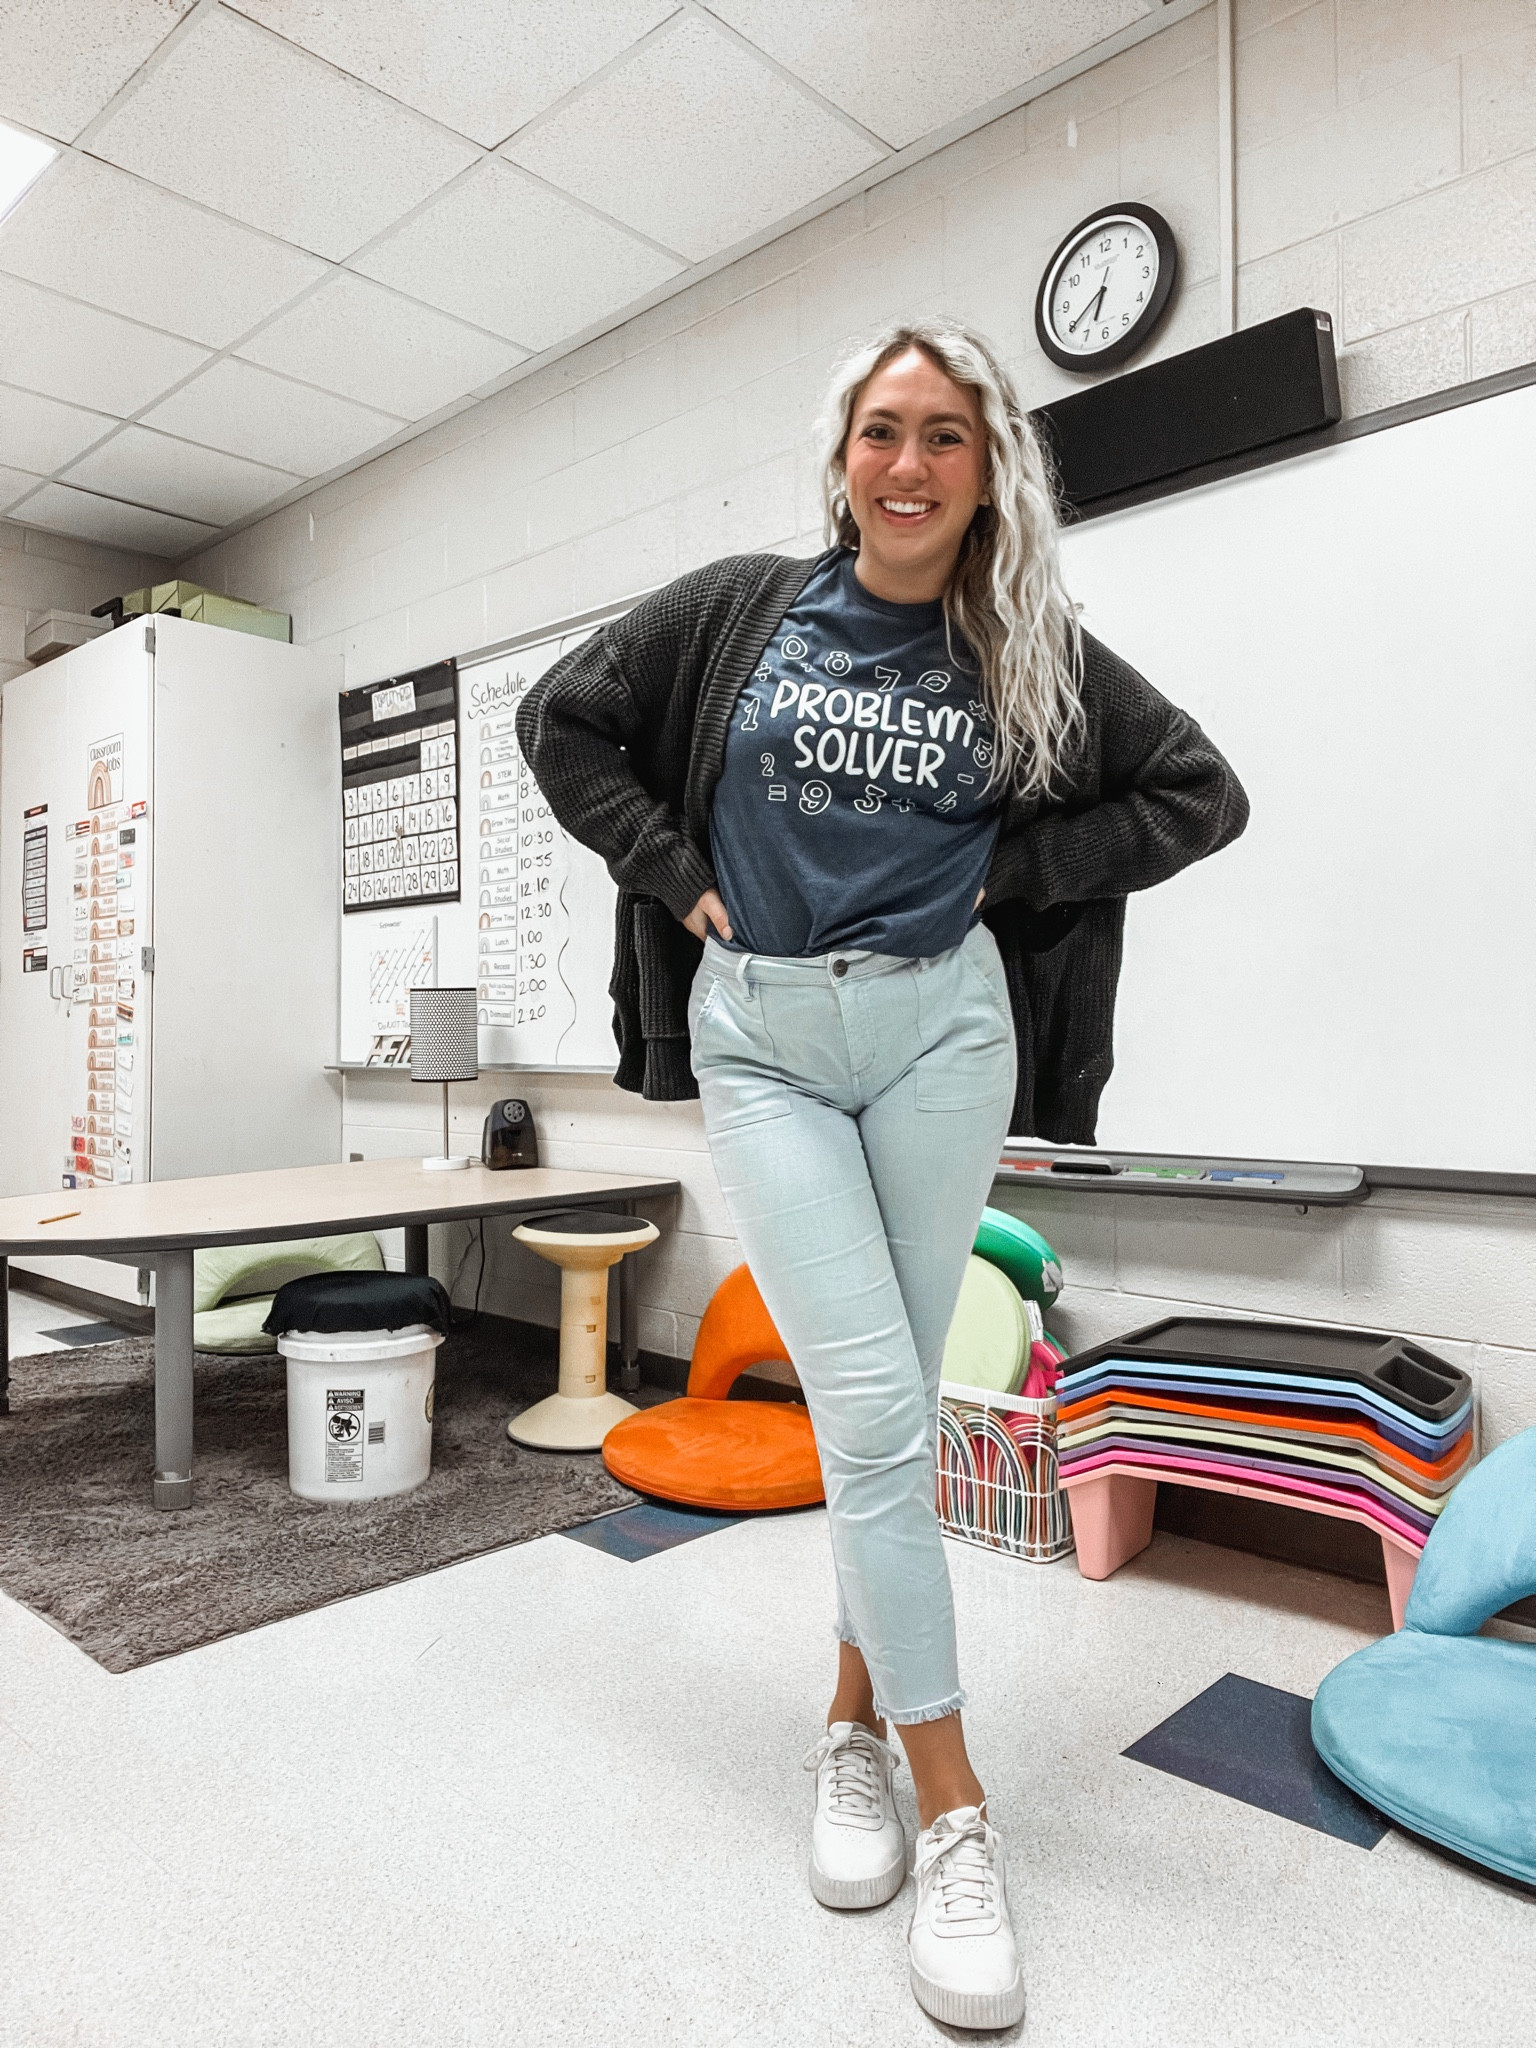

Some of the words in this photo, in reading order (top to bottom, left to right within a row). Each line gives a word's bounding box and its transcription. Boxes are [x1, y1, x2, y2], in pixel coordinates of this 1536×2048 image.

[1099, 238, 1112, 253] 12
[1123, 237, 1128, 248] 1
[1136, 245, 1144, 258] 2
[1080, 254, 1091, 268] 11
[1068, 274, 1080, 288] 10
[1142, 266, 1150, 279] 3
[1136, 291, 1144, 303] 4
[1062, 301, 1070, 313] 9
[1122, 313, 1130, 326] 5
[1083, 329, 1090, 342] 7
[1102, 327, 1109, 339] 6
[825, 651, 852, 677] 8
[875, 665, 901, 692] 7
[471, 671, 529, 707] Schedule
[741, 698, 761, 731] 1
[444, 742, 450, 760] 2
[793, 725, 946, 789] SOLVER
[760, 753, 775, 777] 2
[349, 795, 354, 811] 3
[362, 793, 368, 806] 4
[377, 788, 382, 805] 5
[392, 785, 399, 801] 6
[409, 782, 414, 799] 7
[425, 778, 432, 794] 8
[444, 774, 450, 791] 9
[799, 779, 832, 815] 9
[854, 784, 888, 814] 3
[934, 791, 957, 813] 4
[376, 818, 384, 835] 12
[408, 812, 416, 829] 14
[424, 808, 433, 826] 15
[442, 805, 452, 823] 16
[521, 830, 554, 848] 10:30
[362, 851, 370, 867] 18
[376, 848, 385, 865] 19
[407, 844, 416, 861] 21
[422, 840, 435, 858] 22
[441, 837, 454, 855] 23
[520, 852, 552, 870] 10:55
[348, 883, 357, 899] 24
[362, 880, 372, 897] 25
[376, 878, 387, 895] 26
[392, 875, 401, 892] 27
[406, 872, 418, 891] 28
[424, 870, 437, 889] 29
[443, 866, 454, 886] 30
[521, 902, 552, 920] 12:30
[520, 953, 546, 972] 1:30
[519, 979, 547, 995] 2:00
